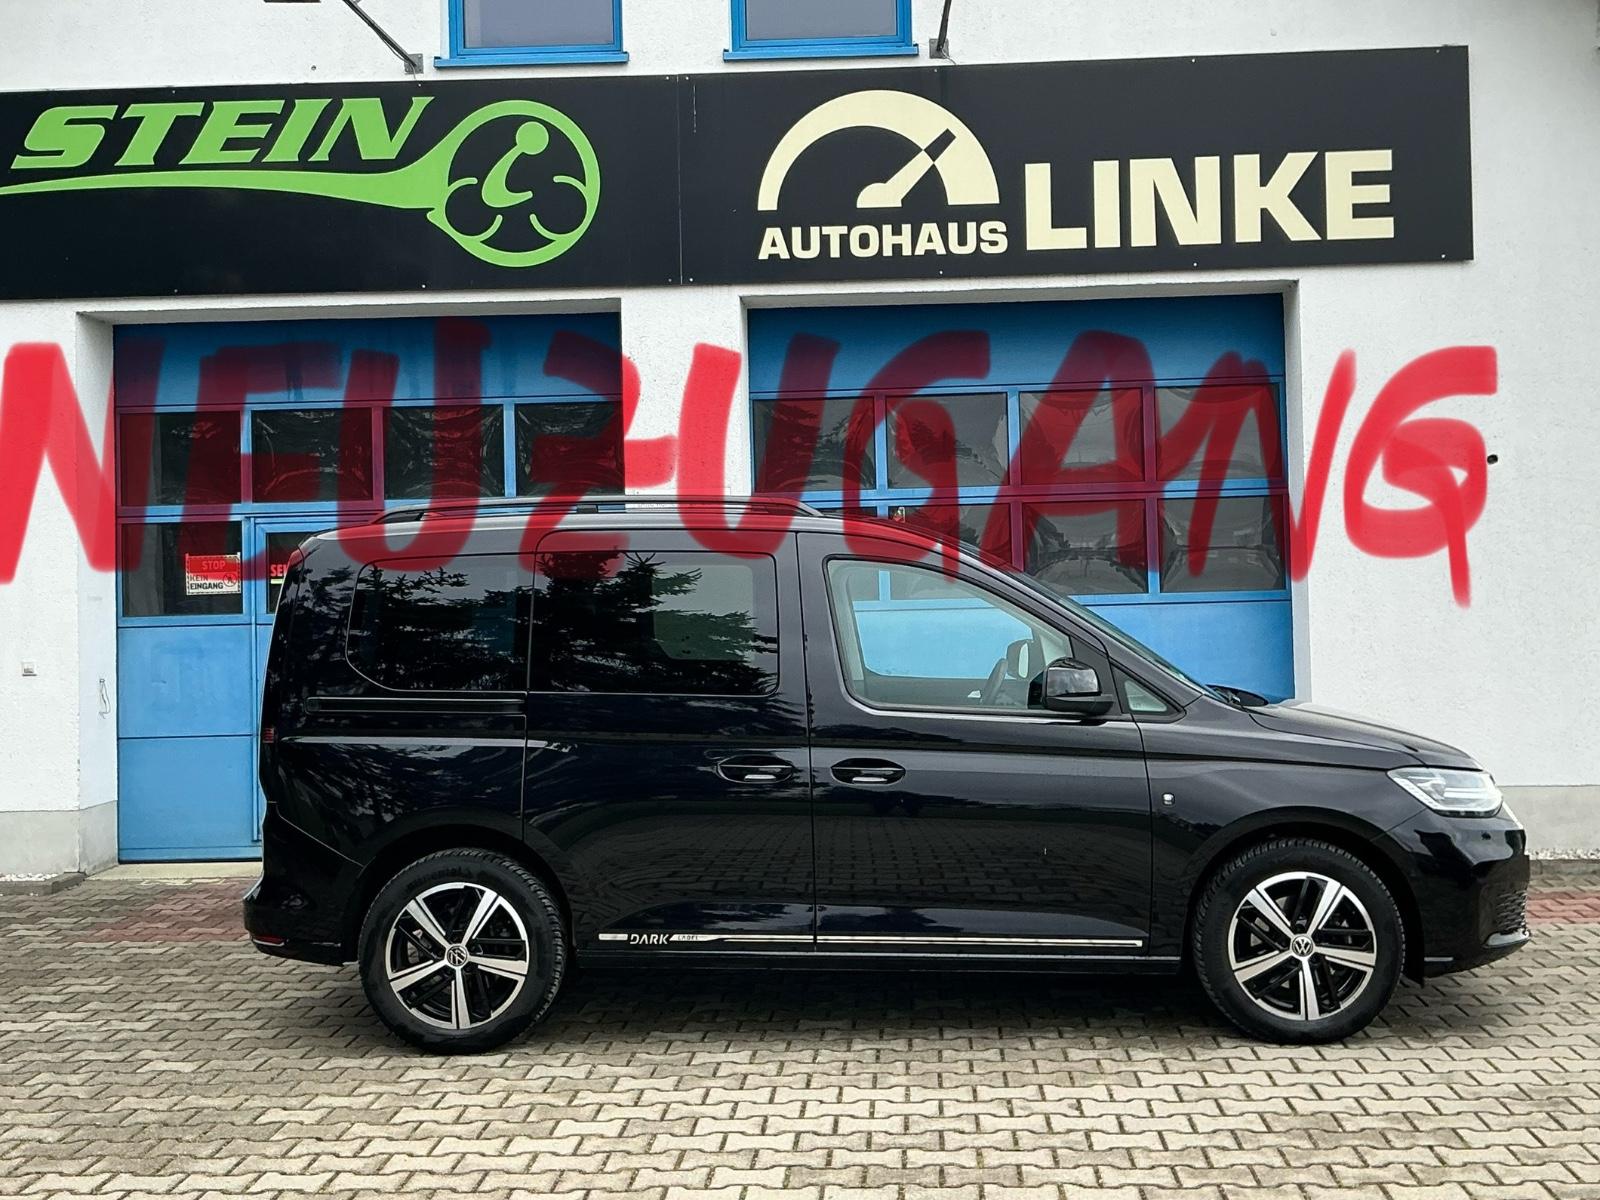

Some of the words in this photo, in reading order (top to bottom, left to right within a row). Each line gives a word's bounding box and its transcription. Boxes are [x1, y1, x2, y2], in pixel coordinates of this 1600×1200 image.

[11, 96, 435, 169] STEIN
[757, 220, 1008, 260] AUTOHAUS
[1024, 149, 1396, 251] LINKE
[202, 560, 226, 570] STOP
[190, 574, 209, 582] KEIN
[190, 582, 223, 590] EINGANG
[630, 933, 669, 944] DARK
